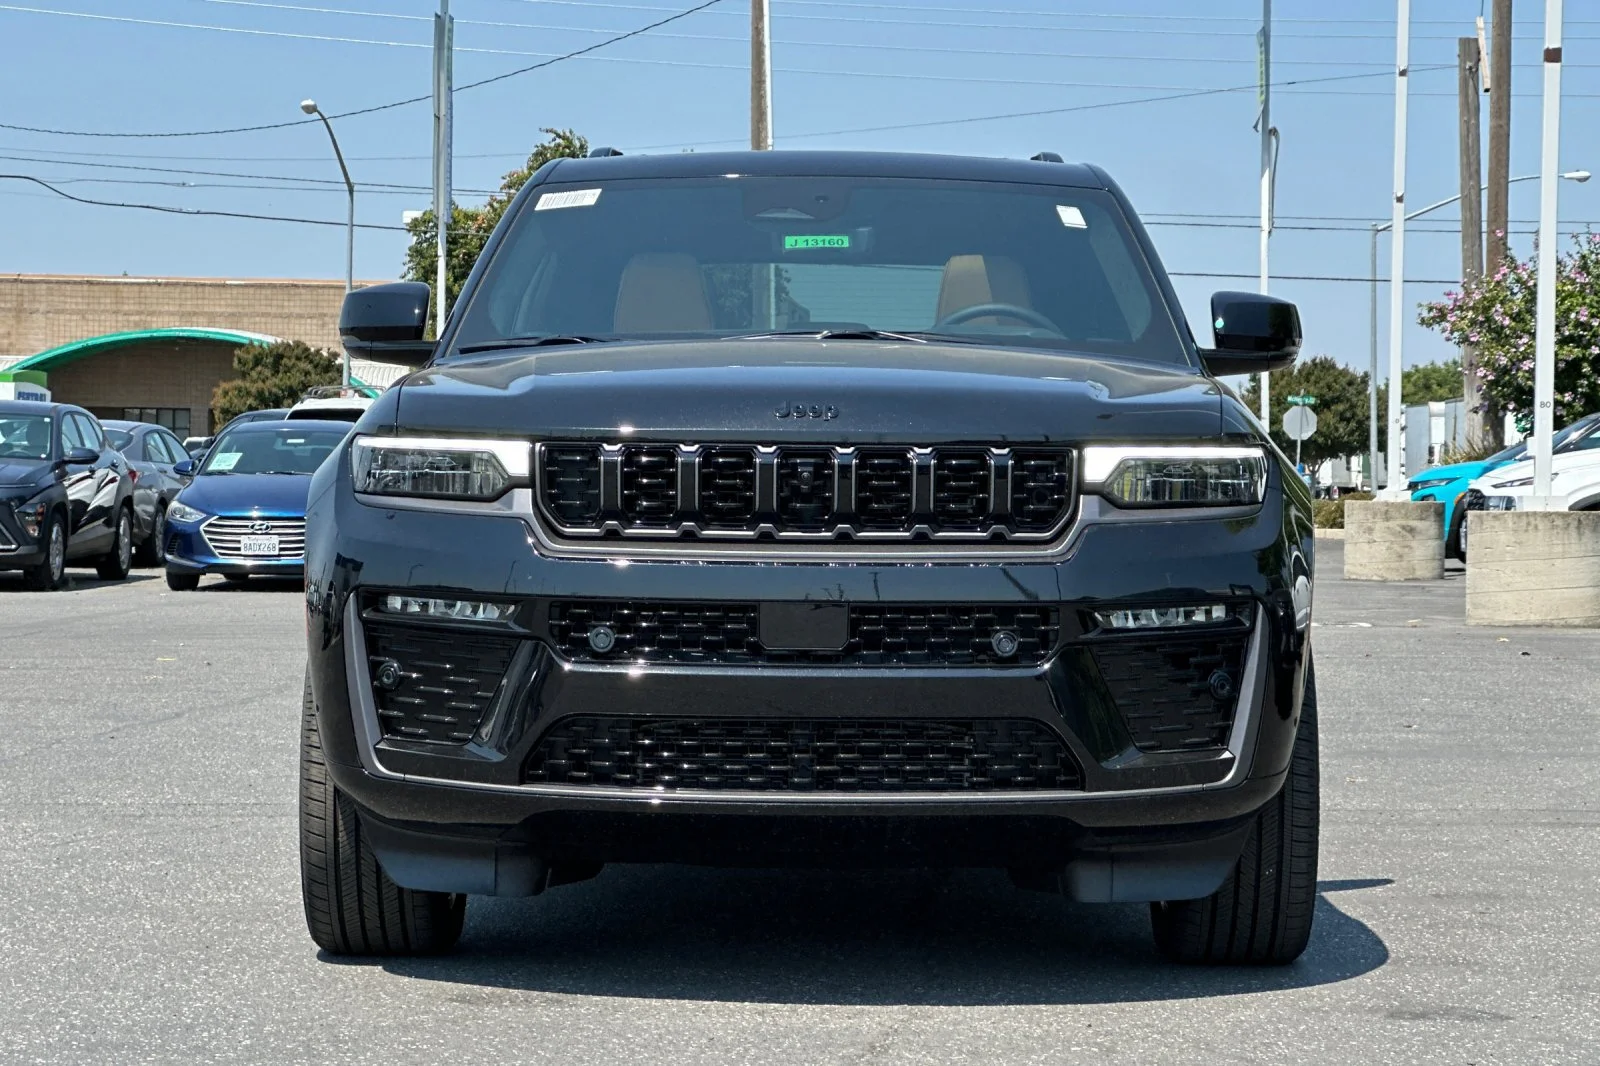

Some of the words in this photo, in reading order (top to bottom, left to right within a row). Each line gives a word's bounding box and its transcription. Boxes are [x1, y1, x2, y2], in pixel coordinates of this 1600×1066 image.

[790, 239, 798, 247] J
[802, 238, 845, 247] 13160
[1539, 400, 1552, 409] 80
[773, 400, 840, 422] Jeep
[243, 542, 277, 552] 8ADX268
